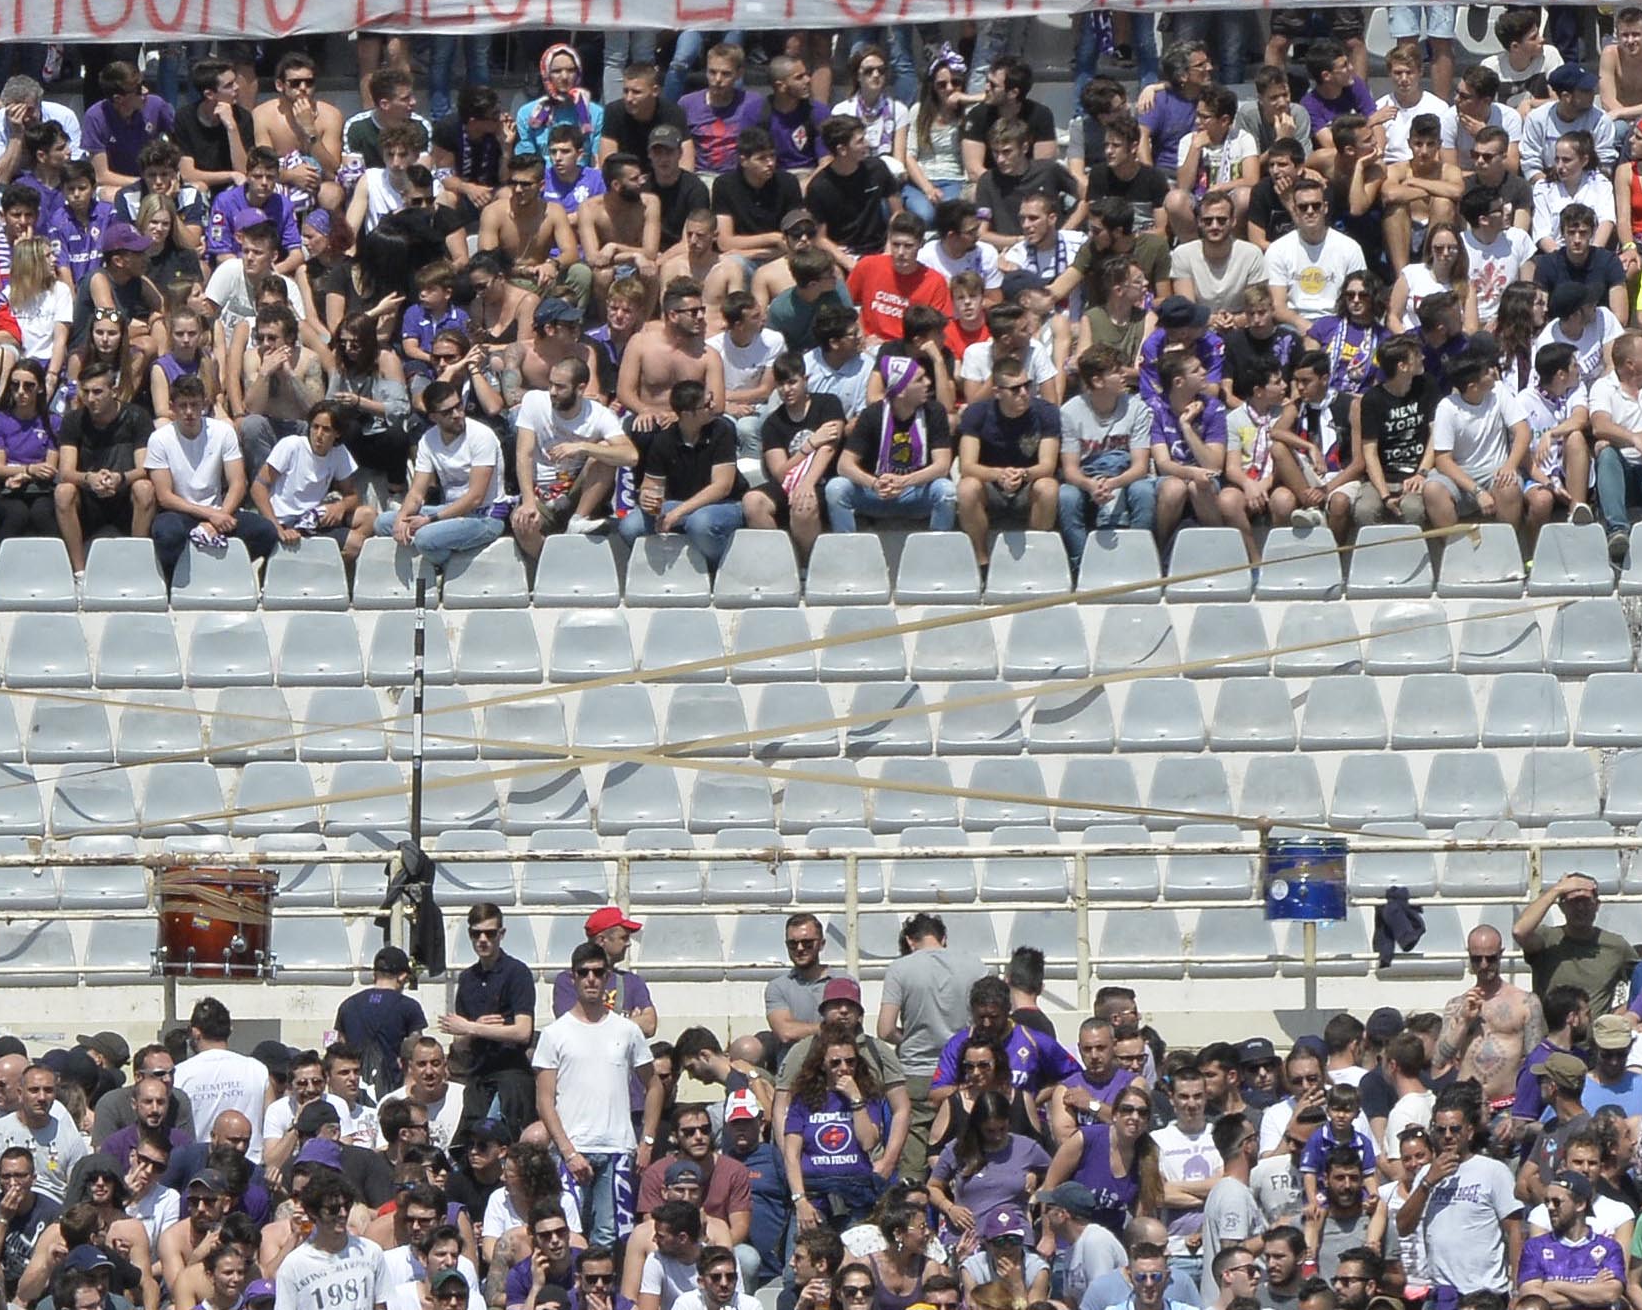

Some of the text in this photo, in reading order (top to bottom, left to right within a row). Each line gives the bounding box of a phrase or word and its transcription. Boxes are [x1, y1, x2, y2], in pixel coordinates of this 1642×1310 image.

[1390, 402, 1418, 420] NEW
[1385, 416, 1424, 432] YORK
[194, 1080, 241, 1092] SEMPRE
[311, 1276, 370, 1310] 1981
